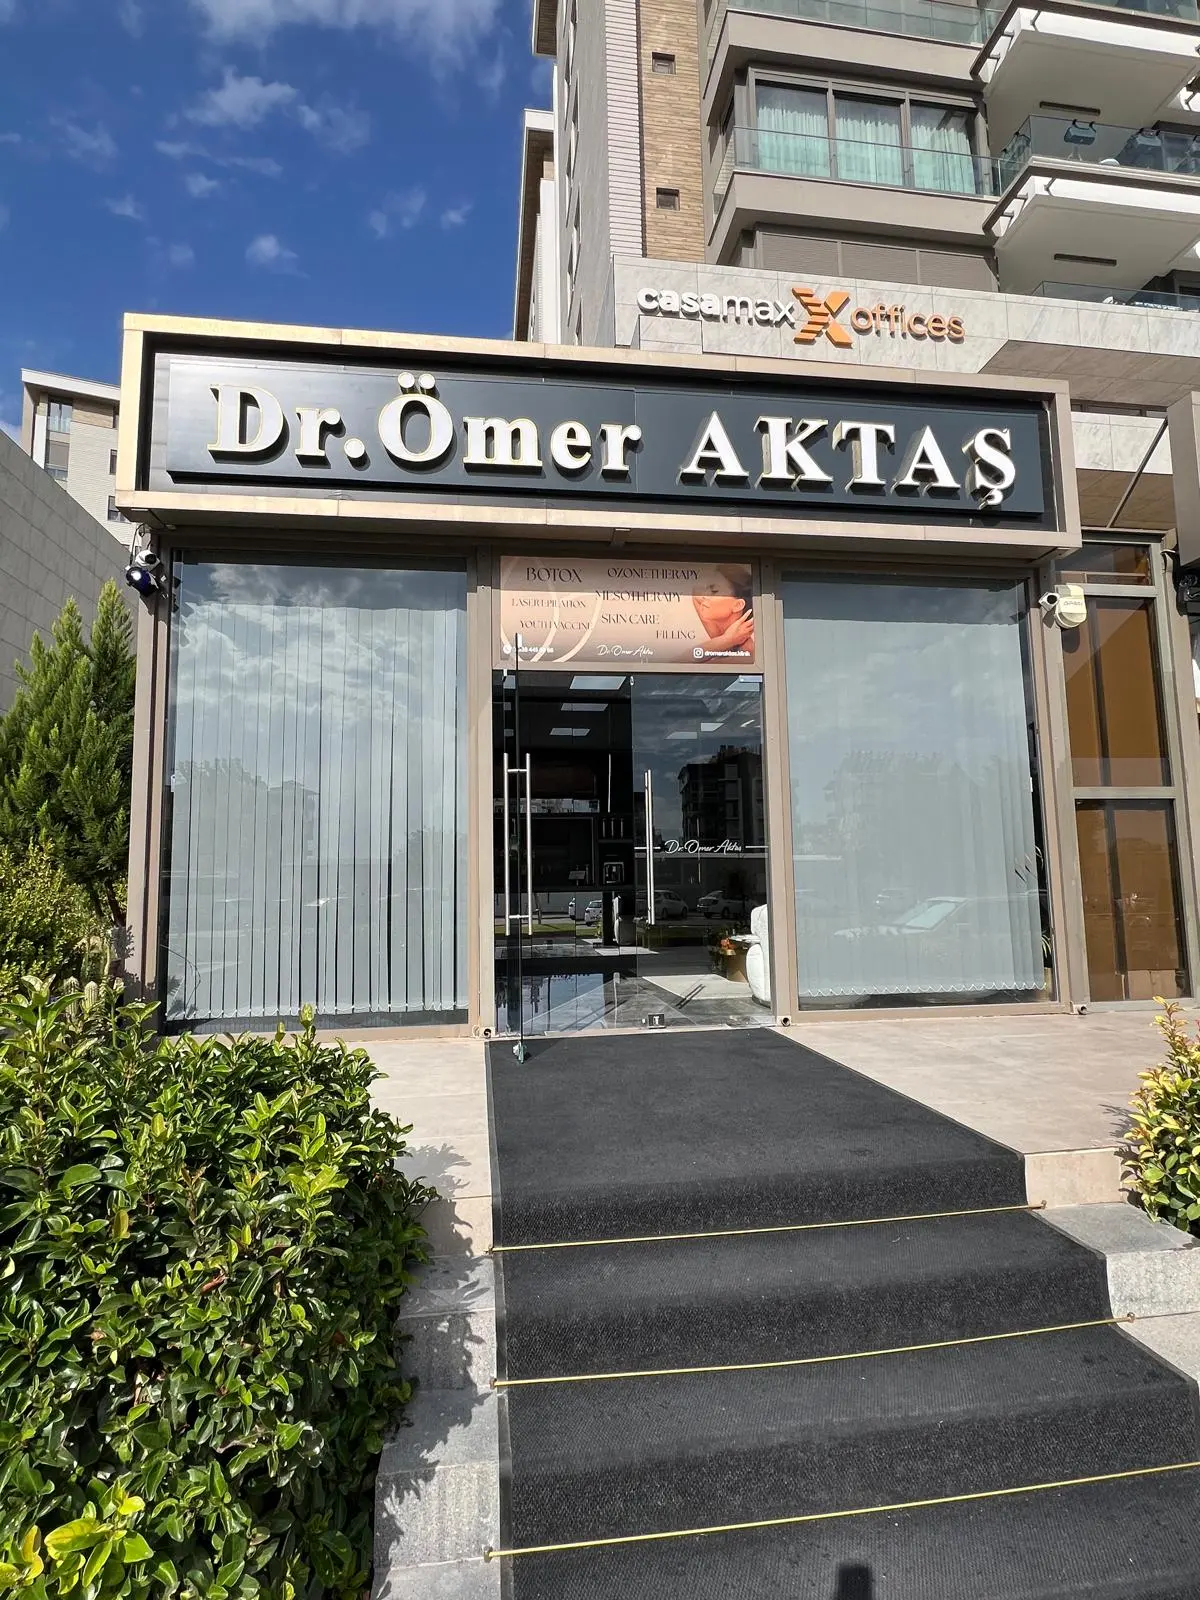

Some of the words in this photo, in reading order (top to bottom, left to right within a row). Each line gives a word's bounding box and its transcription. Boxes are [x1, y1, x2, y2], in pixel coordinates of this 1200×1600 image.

[637, 287, 796, 327] casamax
[851, 303, 966, 344] offices
[680, 410, 1016, 507] AKTAŞ
[526, 567, 582, 583] BOTOX
[595, 590, 684, 603] MESOTHERAPY
[601, 613, 627, 623] SKIN
[629, 614, 660, 624] CARE
[655, 630, 696, 640] FILLING
